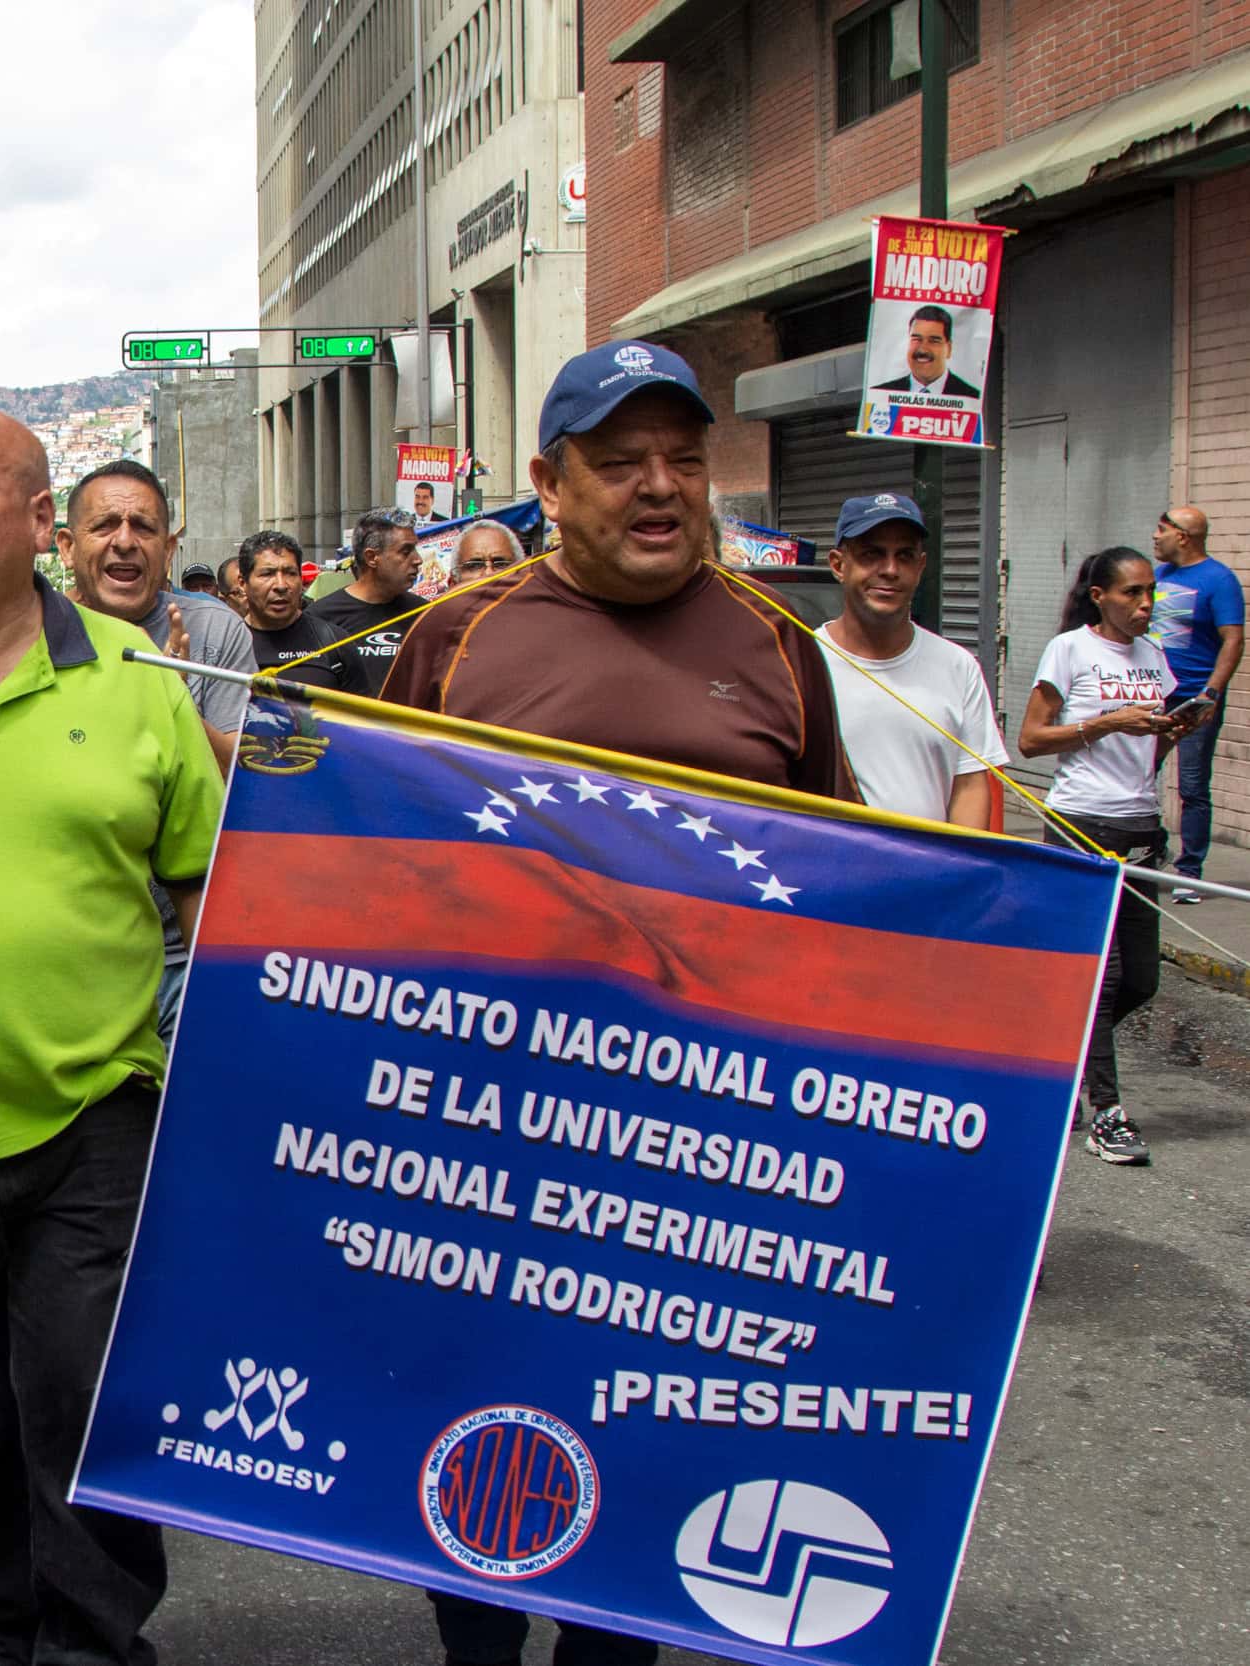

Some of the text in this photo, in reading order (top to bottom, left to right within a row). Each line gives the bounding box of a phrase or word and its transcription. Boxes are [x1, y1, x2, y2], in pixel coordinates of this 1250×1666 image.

[884, 253, 987, 296] MADURO
[936, 227, 988, 262] VOTA
[883, 287, 982, 305] PRESIDENTE
[926, 397, 964, 409] MADURO
[402, 460, 450, 477] MADURO
[259, 951, 987, 1150] SINDICATO NACIONAL OBRERO
[365, 1058, 845, 1205] DE LA UNIVERSIDAD
[273, 1122, 895, 1304] NACIONAL EXPERIMENTAL
[590, 1369, 973, 1438] ¡PRESENTE!
[156, 1436, 336, 1496] FENASOESV
[428, 1410, 595, 1510] SINDICATO NACIONAL DE OBREROS UNIVERSIDAD
[427, 1485, 589, 1574] NACIONAL EXPERIMENTAL SIMON RODRIGUEZ
